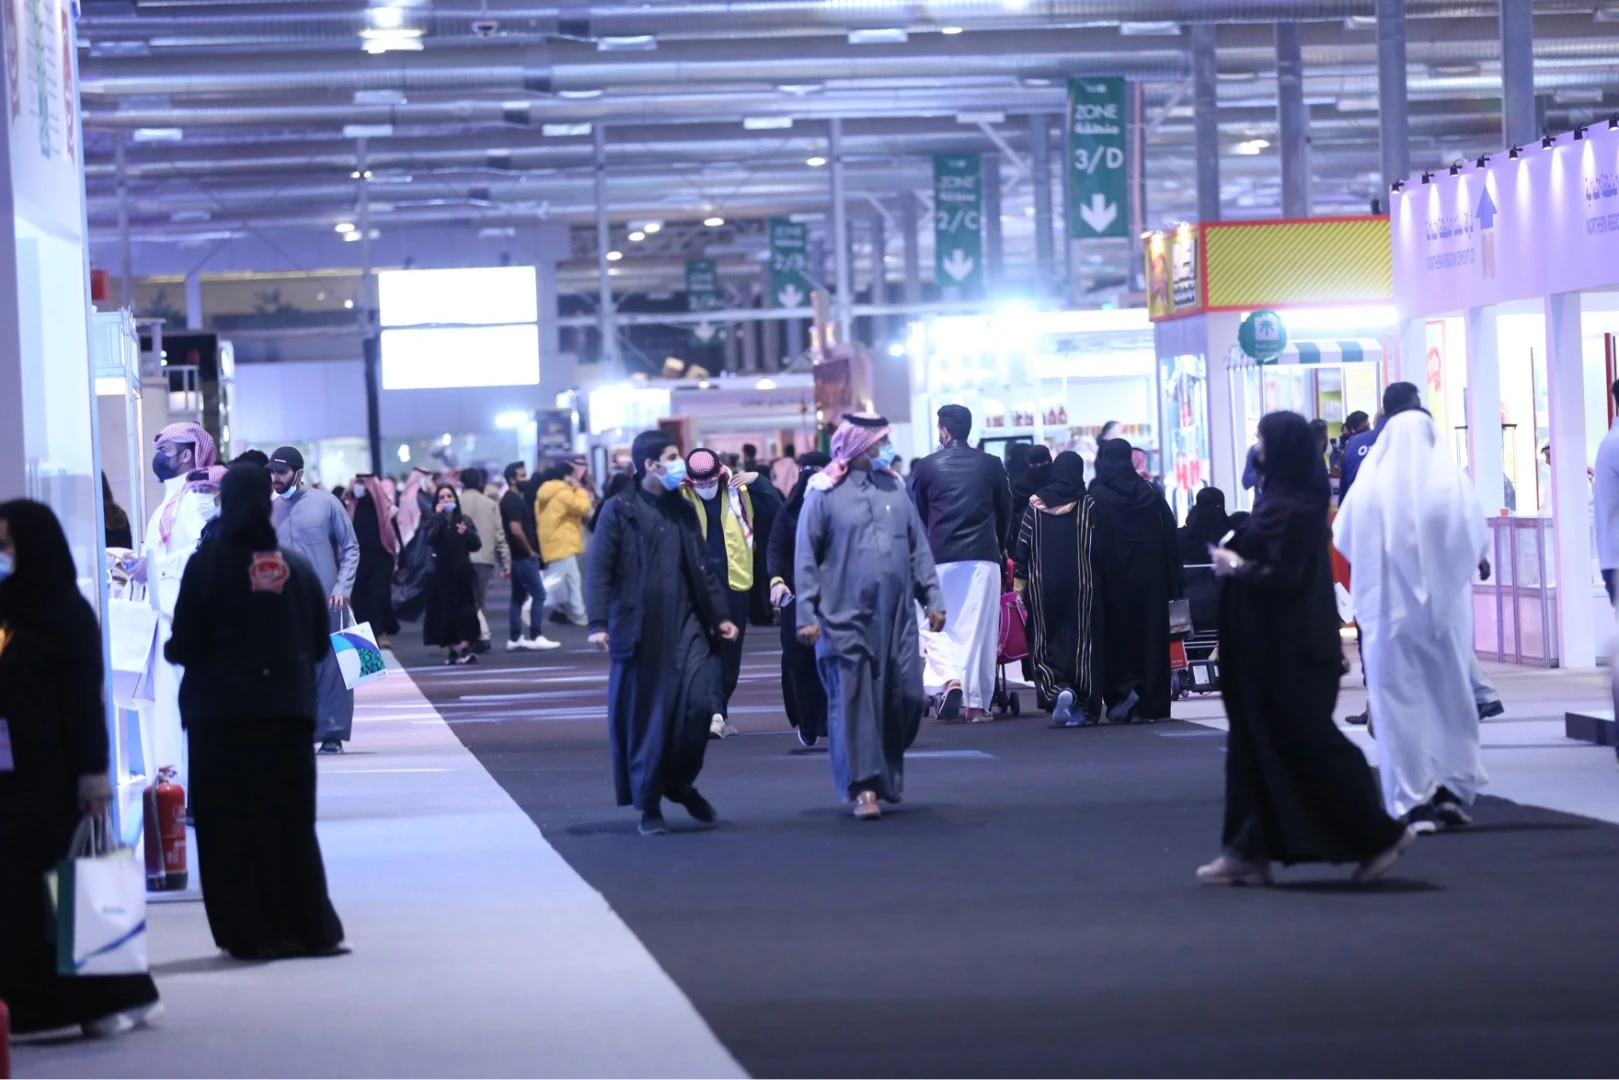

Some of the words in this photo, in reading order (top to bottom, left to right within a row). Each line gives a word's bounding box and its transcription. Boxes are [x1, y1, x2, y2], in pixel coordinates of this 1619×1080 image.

[1074, 104, 1119, 120] ZONE
[1074, 145, 1124, 175] 3/D
[940, 175, 976, 191] ZONE
[937, 209, 980, 235] 2/C
